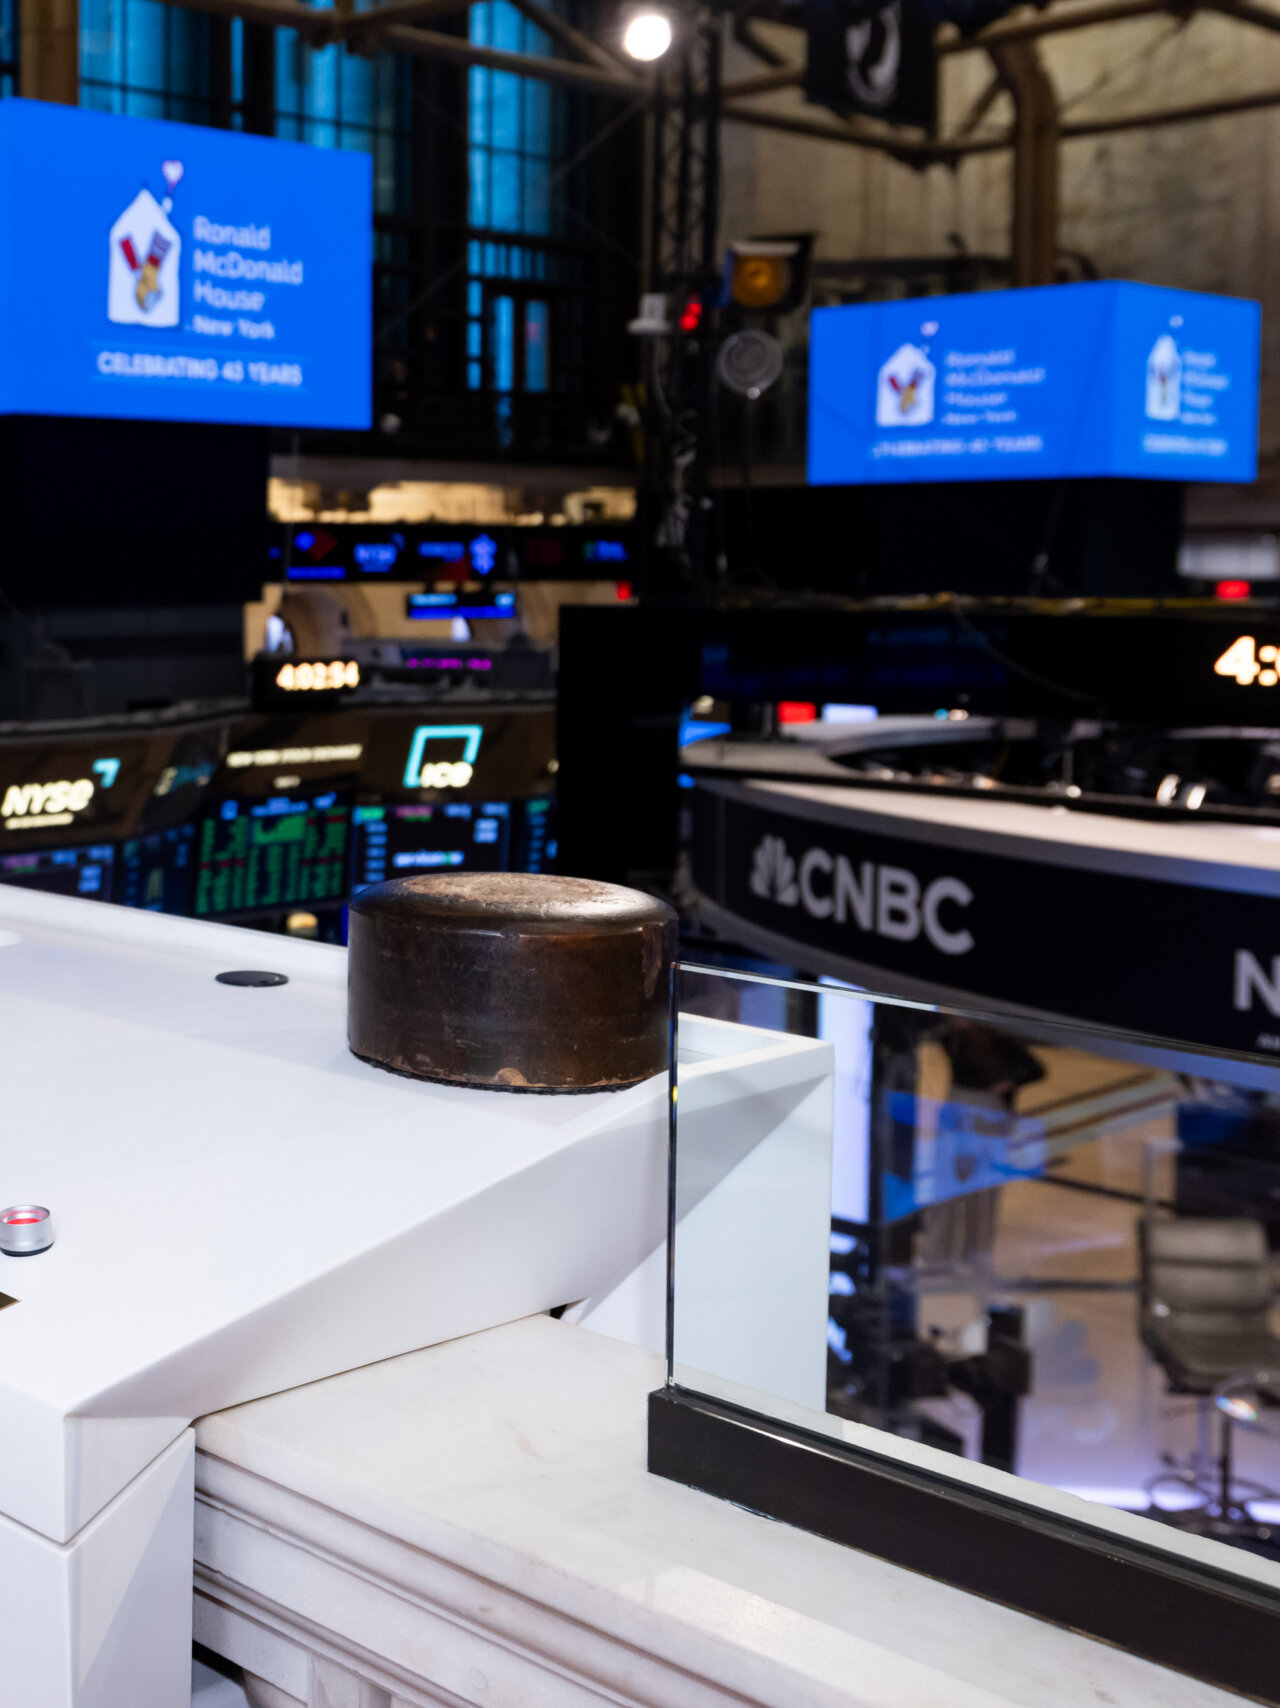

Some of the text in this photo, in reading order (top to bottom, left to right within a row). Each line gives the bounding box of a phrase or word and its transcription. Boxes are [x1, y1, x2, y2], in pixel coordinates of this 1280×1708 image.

[193, 215, 271, 251] Ronald
[193, 248, 303, 286] McDonald
[193, 279, 265, 312] House
[192, 314, 275, 339] New York
[97, 351, 219, 381] CELEBRATING
[247, 361, 303, 387] YEARS
[1, 778, 95, 817] NYSE
[798, 846, 975, 956] CNBC
